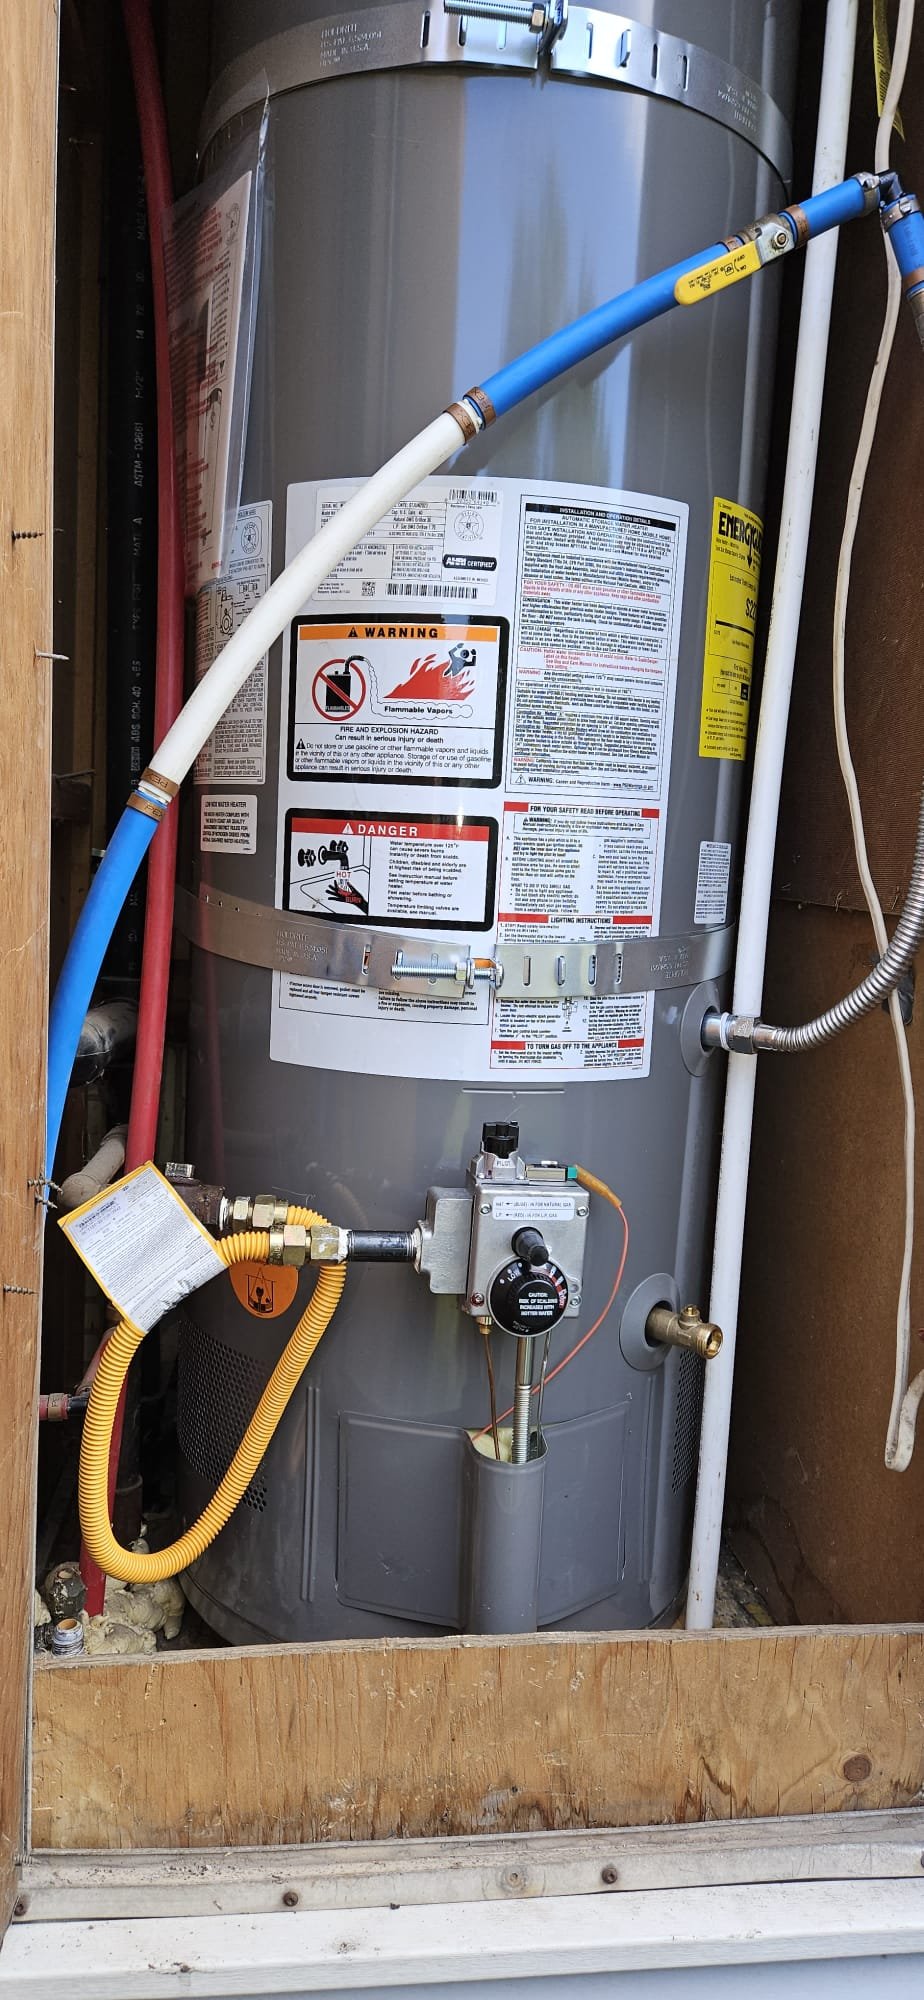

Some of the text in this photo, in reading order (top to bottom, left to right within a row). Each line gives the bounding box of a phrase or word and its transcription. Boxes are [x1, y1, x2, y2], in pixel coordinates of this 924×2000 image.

[364, 627, 439, 638] WARNING
[384, 705, 453, 715] Flammable Vapors
[594, 808, 615, 816] BEFORE
[357, 824, 418, 837] DANGER
